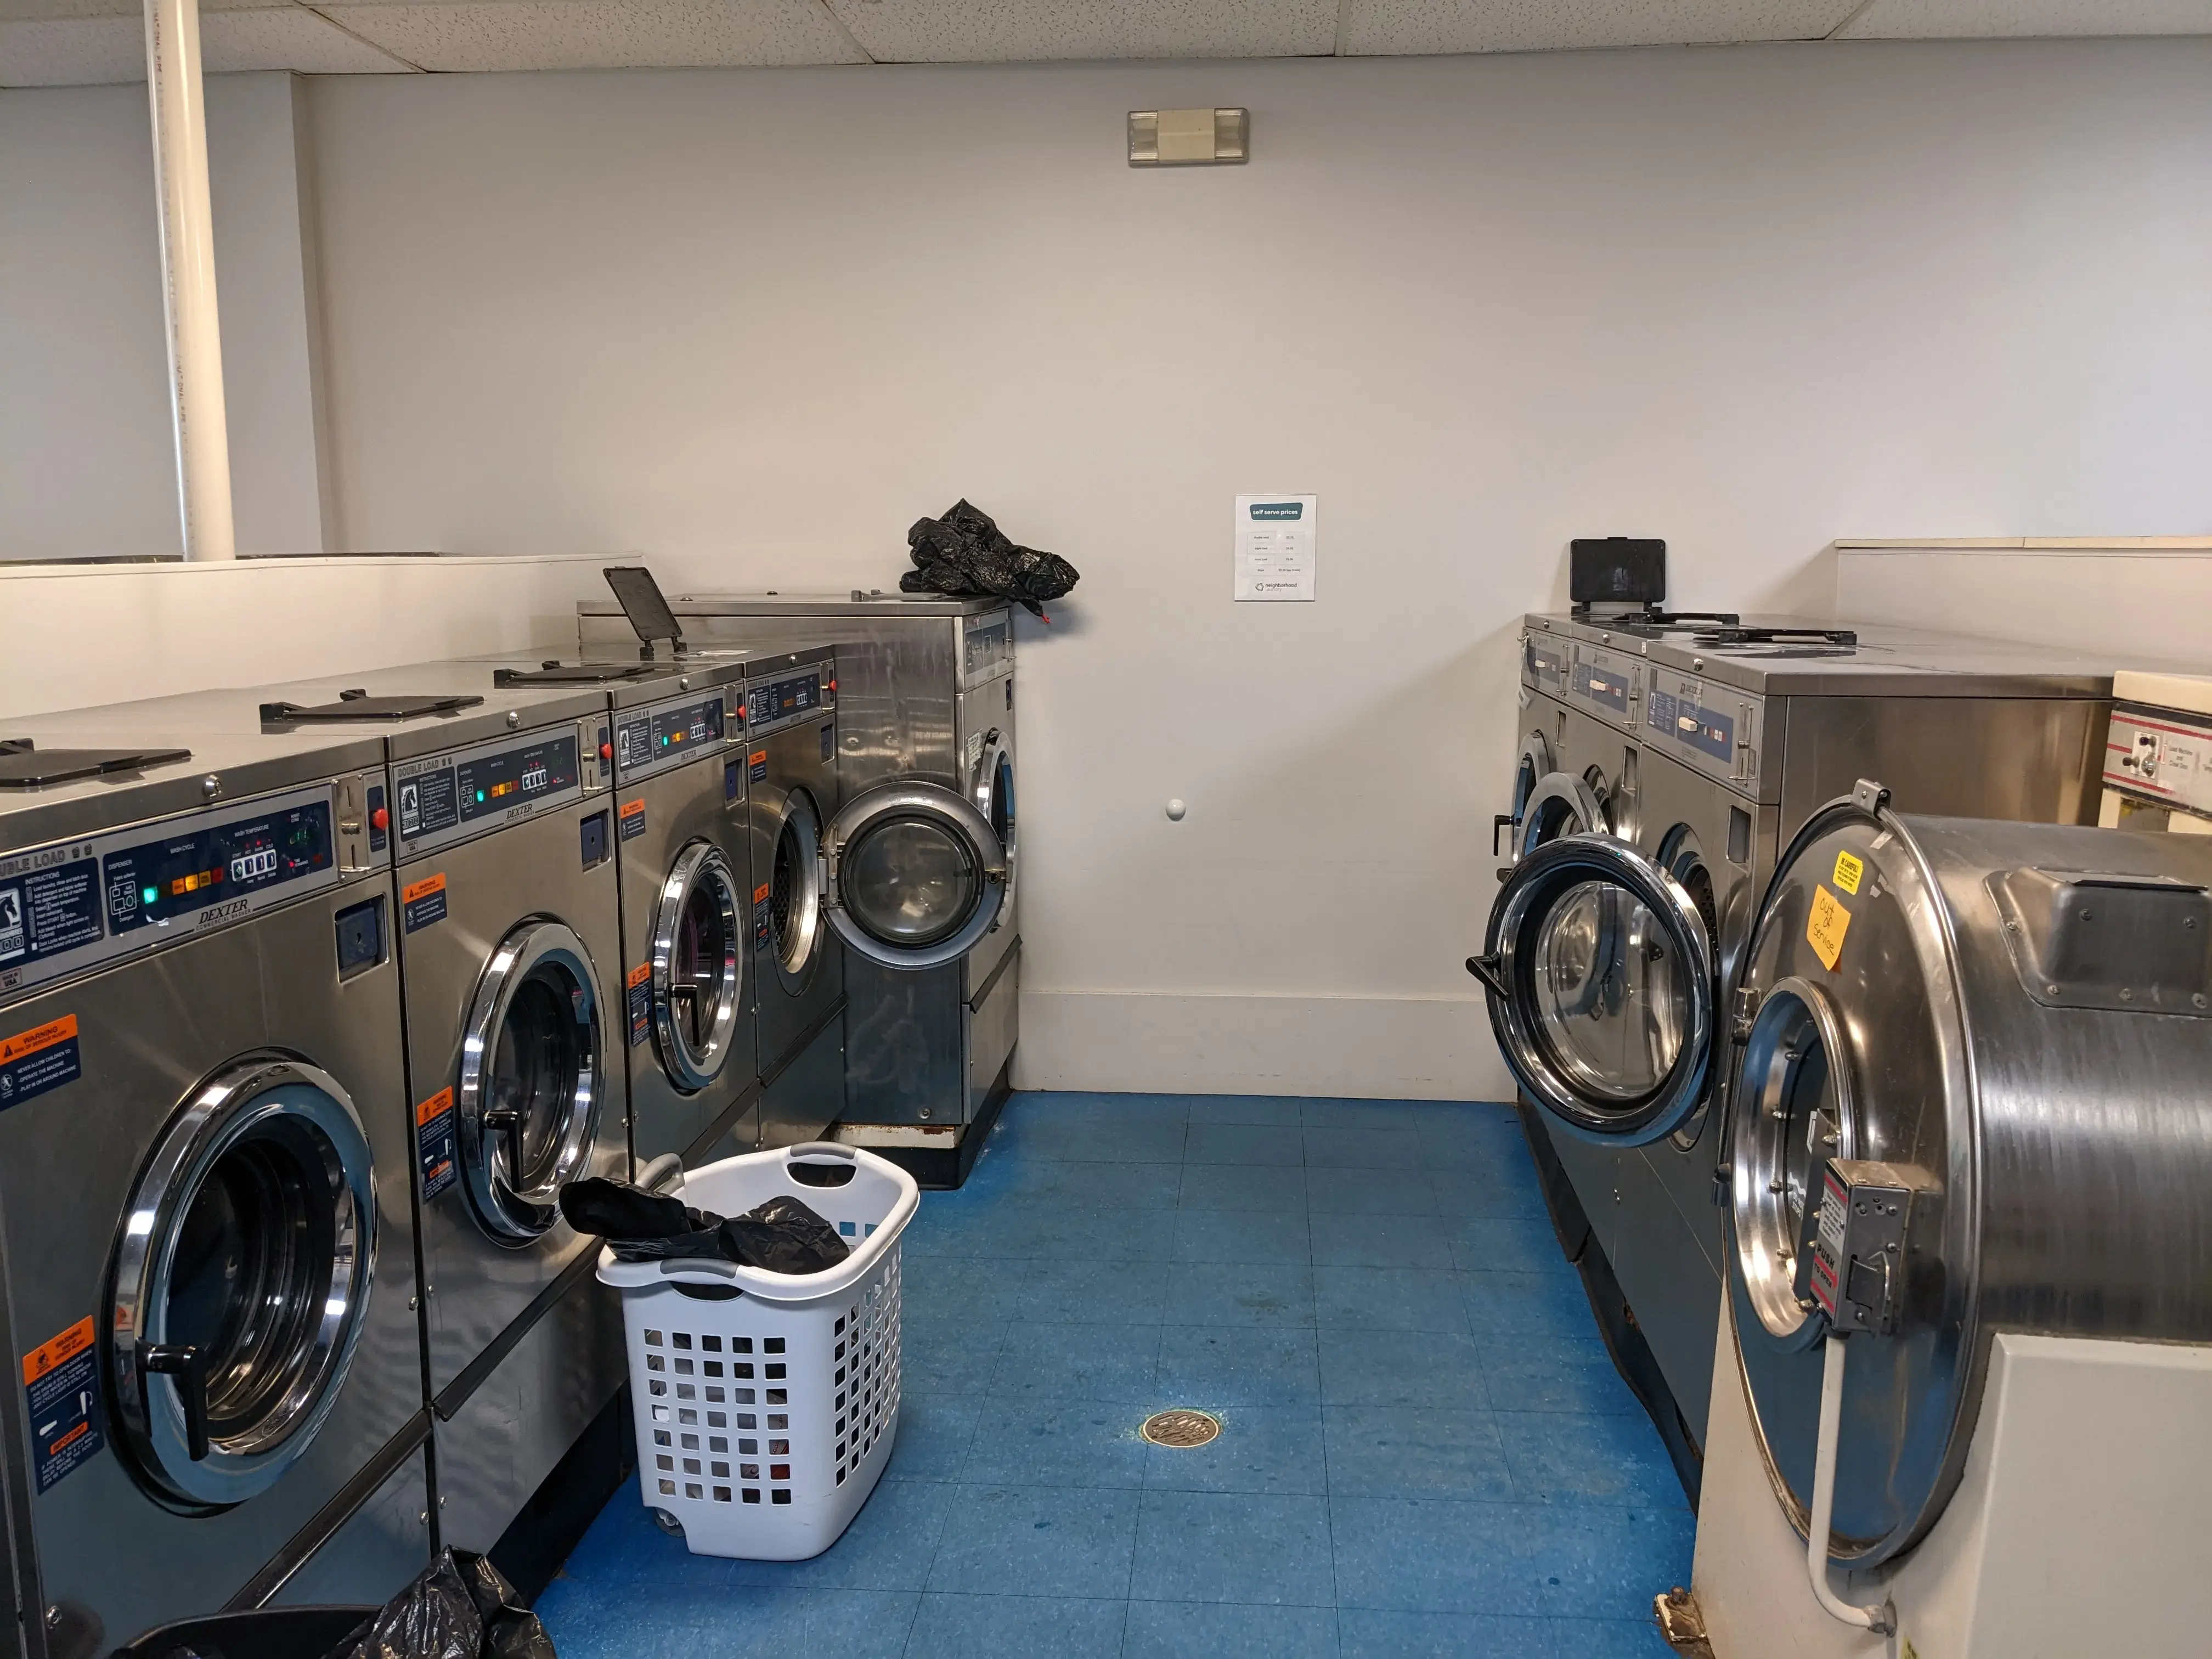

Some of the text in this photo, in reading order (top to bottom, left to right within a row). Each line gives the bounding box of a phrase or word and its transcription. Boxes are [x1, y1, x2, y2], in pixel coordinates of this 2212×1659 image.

[681, 750, 697, 760] DEXTER
[398, 759, 439, 777] DOUBLE LOAD
[506, 804, 532, 819] DEXTER
[402, 816, 420, 829] 300
[35, 850, 65, 868] LOAD
[108, 860, 132, 871] DISPENSER
[25, 872, 60, 885] INSTRUCTIONS
[195, 909, 251, 931] COMMERCIAL WASHER
[199, 899, 248, 924] DEXTER
[0, 934, 24, 952] 00
[4, 978, 17, 987] USA
[24, 1026, 58, 1043] WARNING
[18, 1065, 31, 1074] NEVER
[31, 1059, 45, 1068] ALLOW
[45, 1051, 65, 1062] CHILDREN
[1817, 1243, 1835, 1270] PUSH
[1814, 1263, 1832, 1289] TO OPEN
[54, 1424, 84, 1451] IMPORTANT
